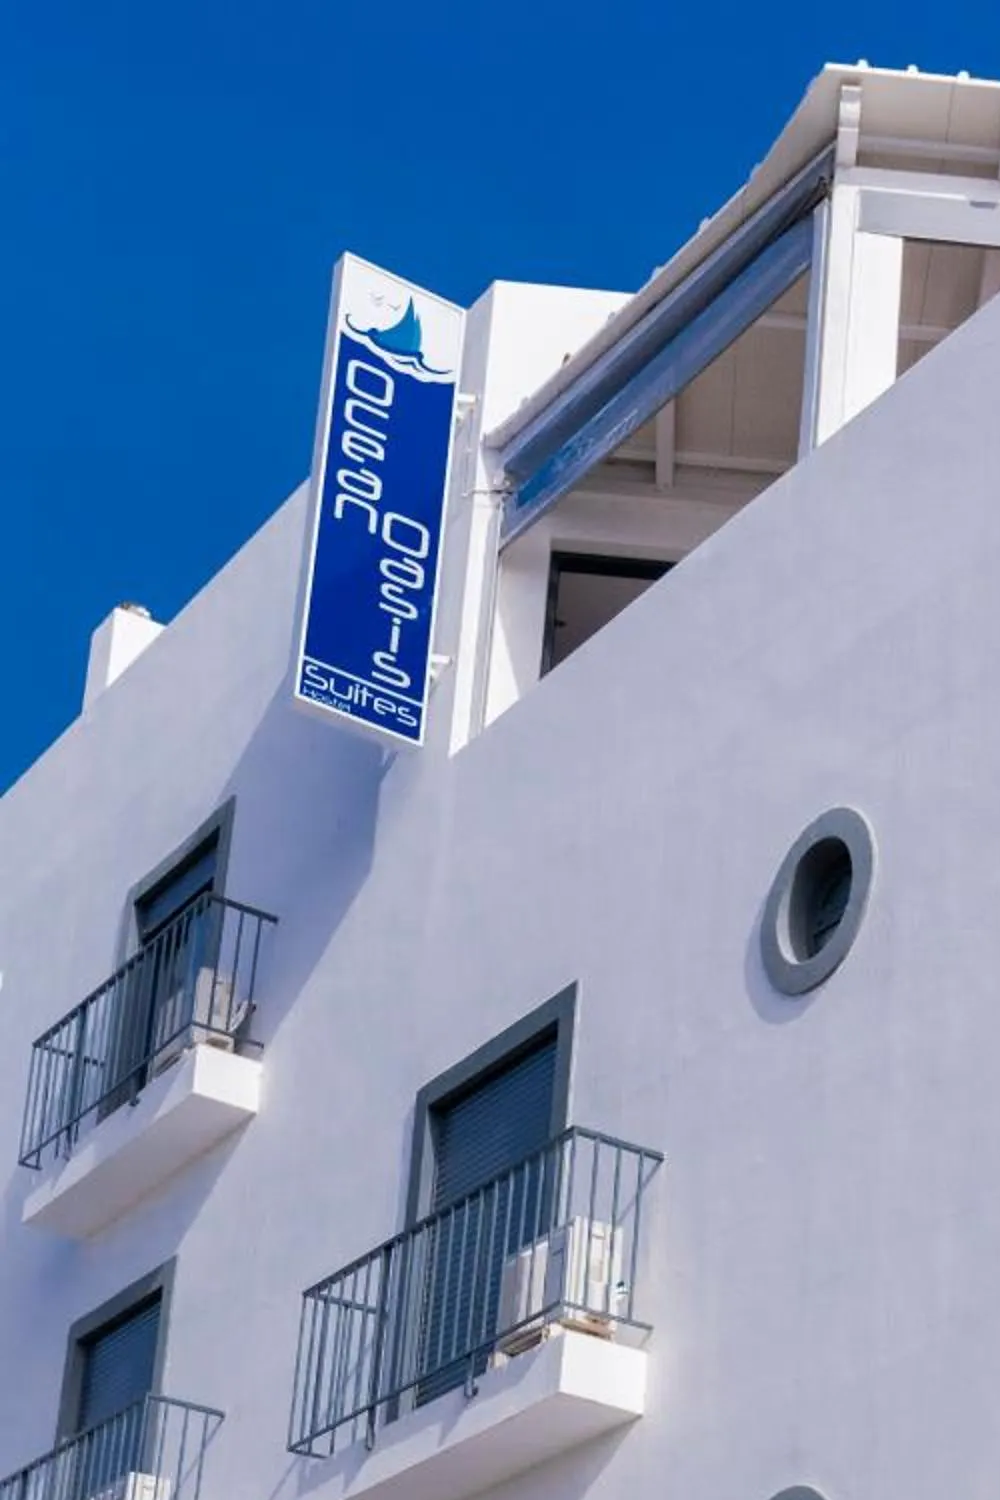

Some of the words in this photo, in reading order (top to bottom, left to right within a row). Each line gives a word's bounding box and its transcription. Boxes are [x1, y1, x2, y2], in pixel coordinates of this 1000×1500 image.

[335, 359, 394, 535] Ocean
[371, 511, 431, 690] Oasis
[304, 665, 417, 727] Suites
